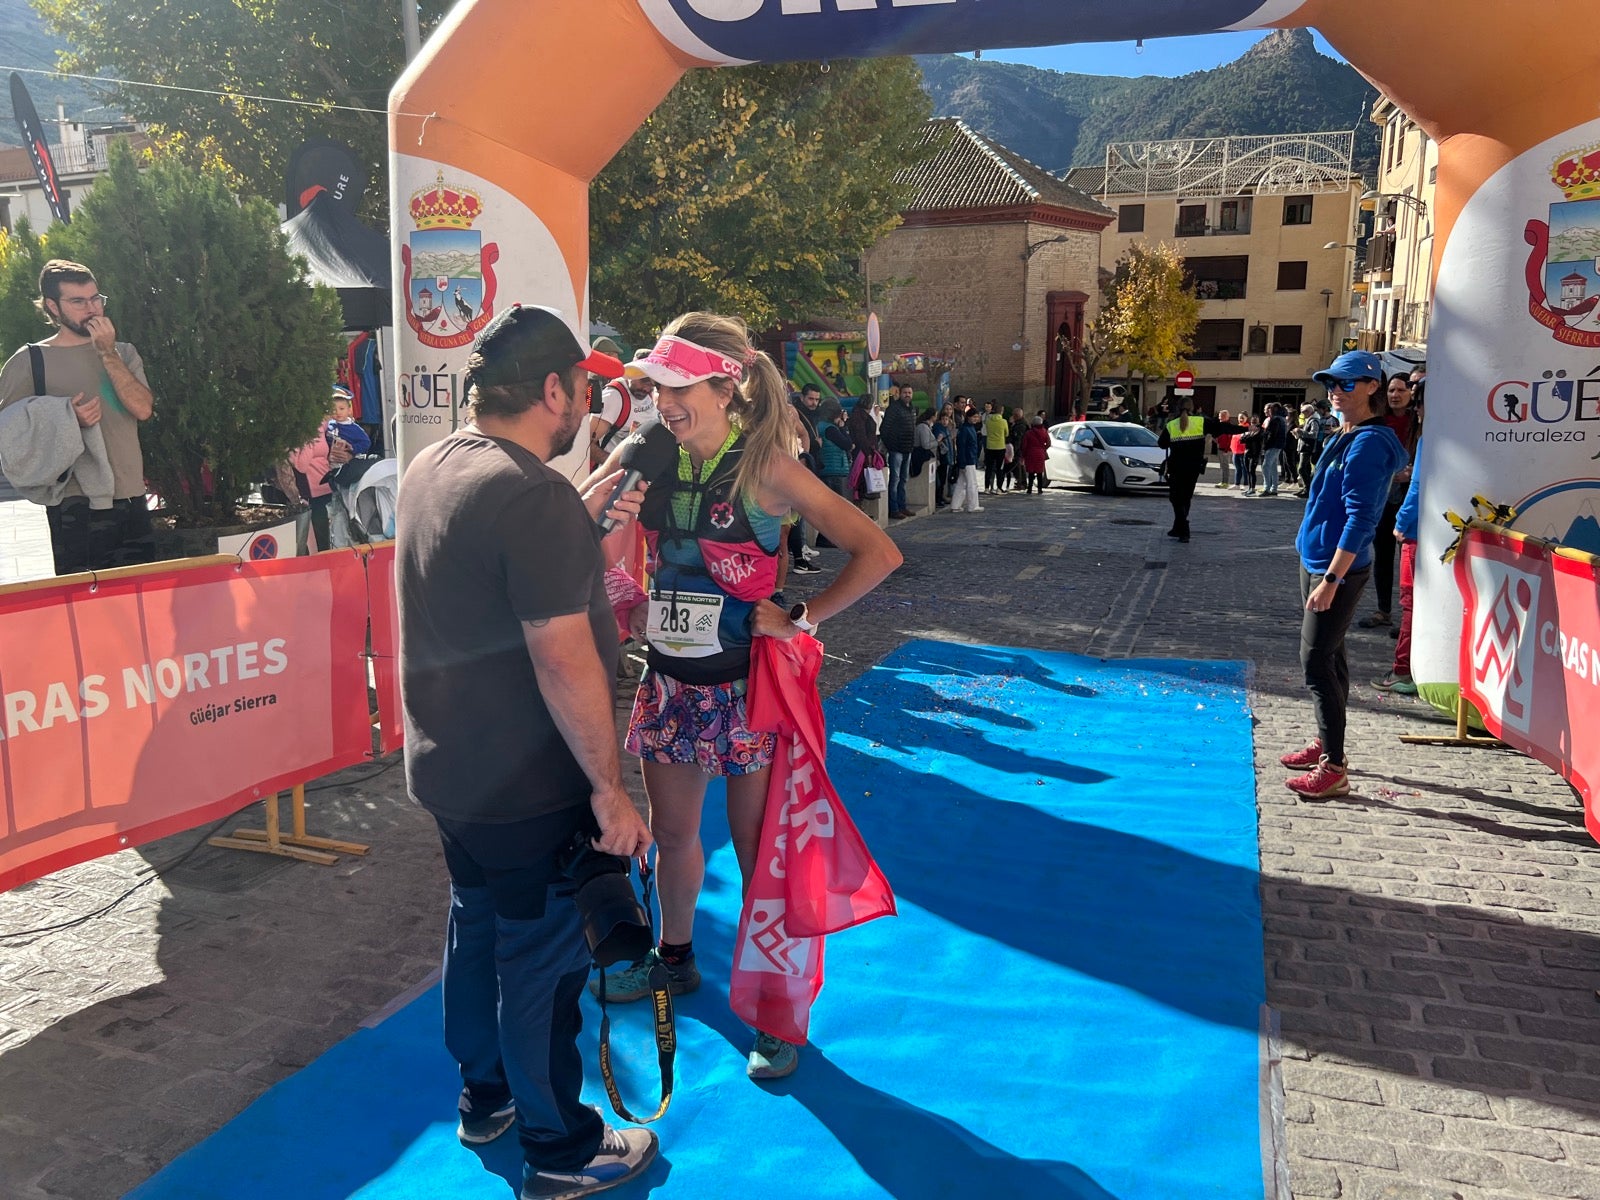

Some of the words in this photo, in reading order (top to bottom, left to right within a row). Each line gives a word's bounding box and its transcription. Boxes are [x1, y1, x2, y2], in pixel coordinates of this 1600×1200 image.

[1487, 365, 1600, 424] GÜÉ
[1485, 428, 1586, 442] naturaleza
[722, 559, 757, 585] MAX
[0, 675, 110, 742] RAS
[122, 638, 288, 709] NORTES
[189, 703, 231, 726] Güéjar
[234, 693, 277, 713] Sierra
[655, 990, 668, 1022] Nikon
